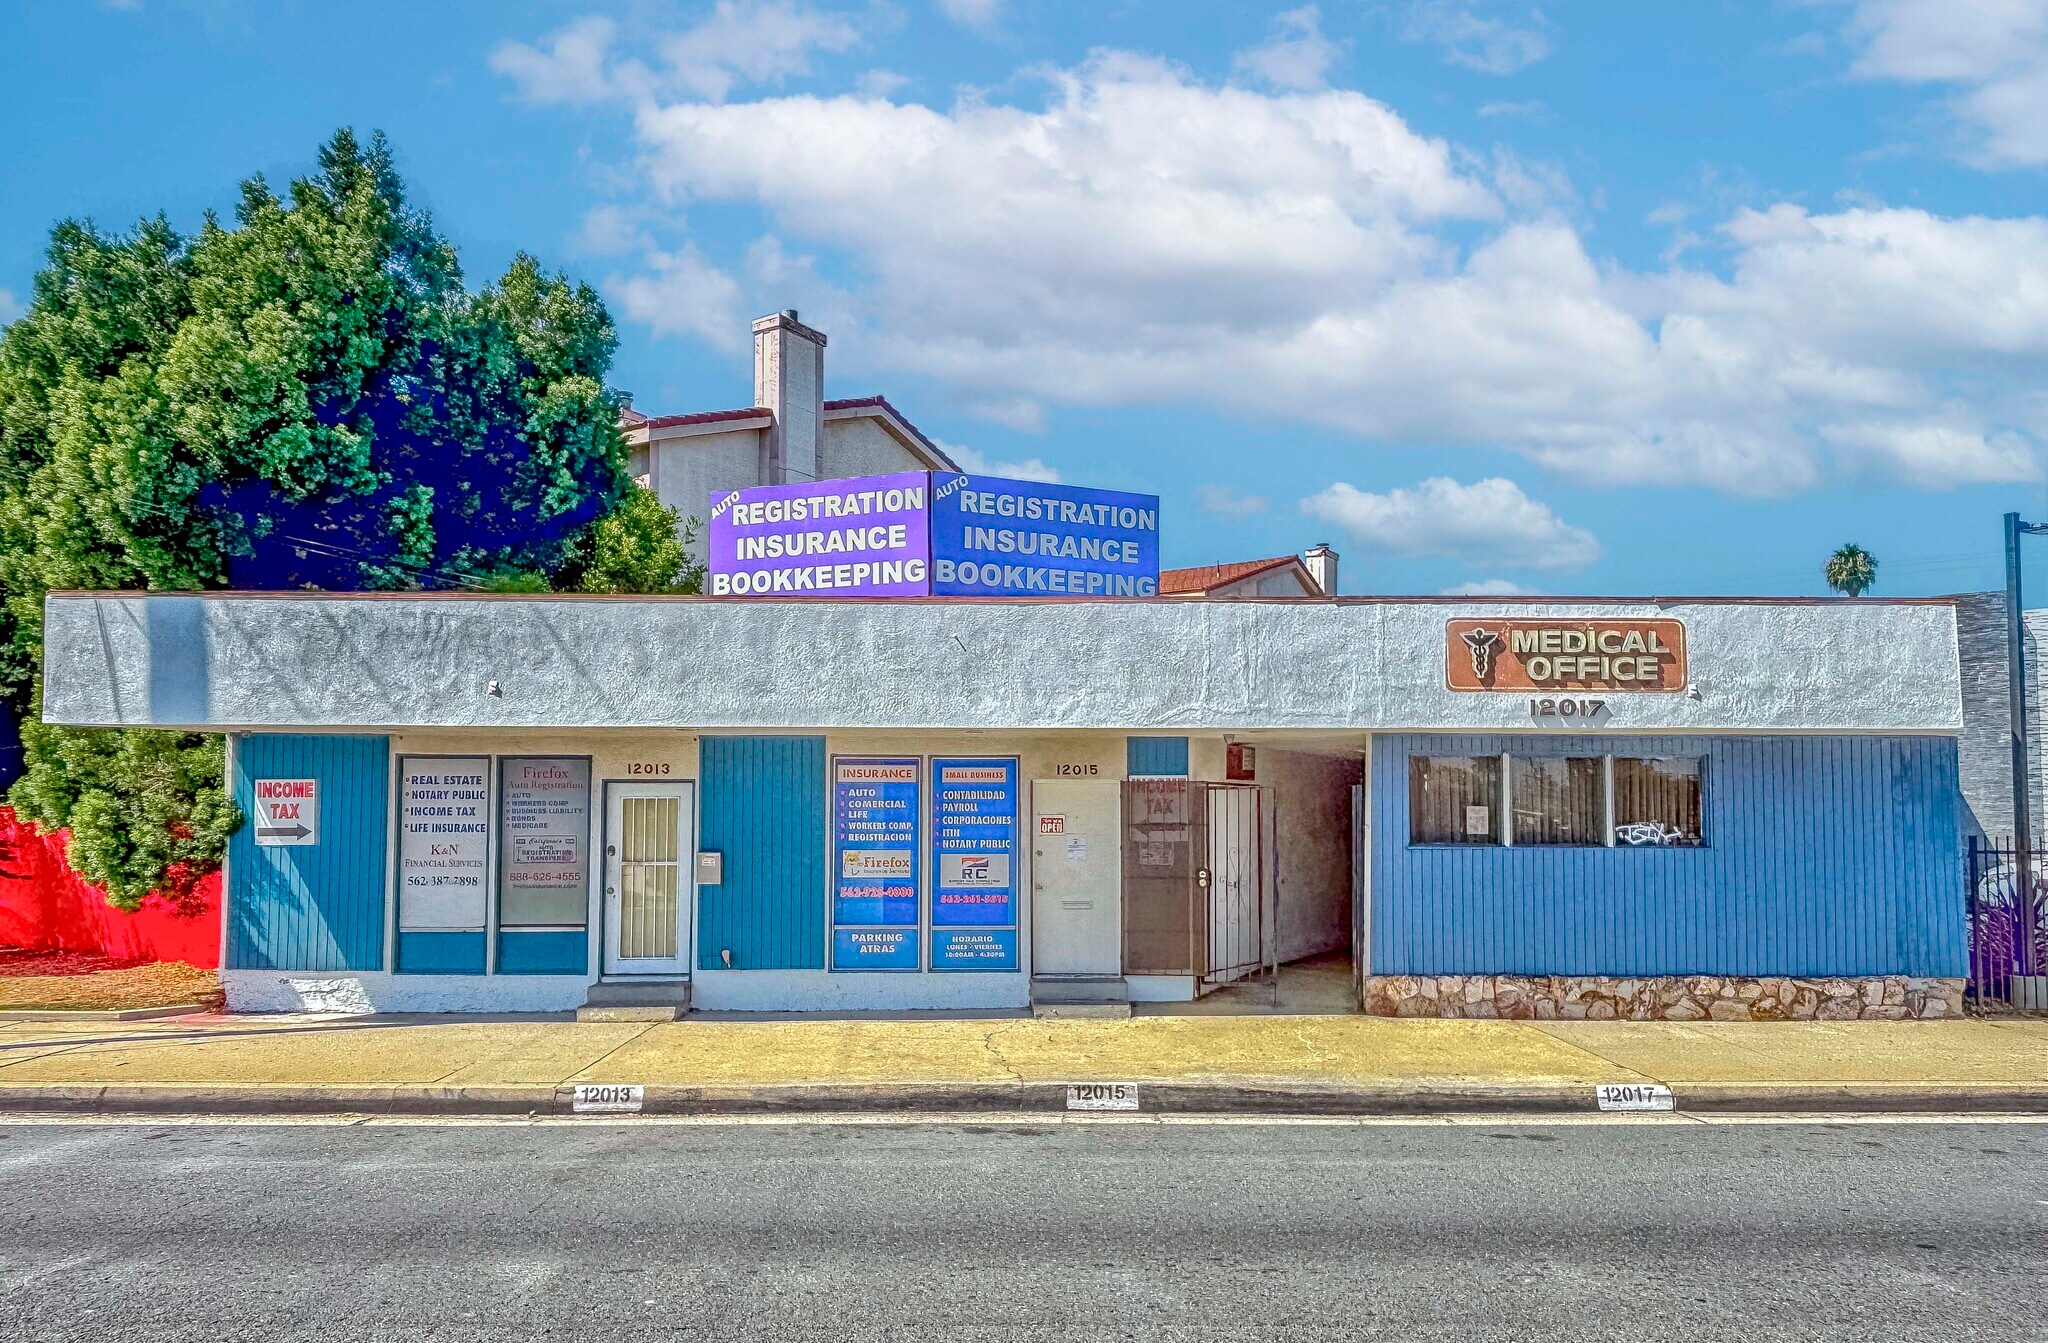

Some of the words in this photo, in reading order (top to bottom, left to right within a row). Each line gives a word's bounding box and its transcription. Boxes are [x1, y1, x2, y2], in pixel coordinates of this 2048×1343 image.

[935, 475, 969, 500] AUTO
[711, 490, 740, 520] AUTO
[732, 487, 923, 527] REGISTRATION
[960, 490, 1156, 531] REGISTRATION
[736, 524, 907, 560] INSURANCE
[964, 526, 1139, 564] INSURANCE
[713, 559, 925, 596] BOOKKEEPING
[936, 559, 1156, 597] BOOKKEEPING
[1511, 629, 1670, 653] MEDICAL
[1526, 656, 1659, 681] OFFICE
[1530, 699, 1606, 717] 12017
[523, 766, 569, 779] Firefox
[627, 763, 671, 775] 12013
[843, 769, 912, 778] INSURANCE
[1057, 764, 1098, 775] 12015
[411, 775, 440, 785] REAL
[443, 775, 482, 785] ESTATE
[257, 782, 314, 799] INCOME
[508, 781, 529, 789] Auto
[531, 781, 584, 791] Registration
[411, 790, 449, 800] NOTARY
[452, 790, 486, 800] PUBLIC
[848, 788, 876, 797] AUTO
[943, 790, 1006, 800] CONTABILIDAD
[848, 800, 907, 808] COMERCIAL
[942, 803, 979, 812] PAYROLL
[270, 803, 300, 819] TAX
[410, 806, 453, 816] INCOME
[456, 806, 476, 816] TAX
[848, 810, 868, 819] LIFE
[848, 822, 886, 830] WORKERS
[888, 822, 914, 830] COMP.
[942, 816, 1012, 825] CORPORACIONES
[410, 823, 429, 833] LIFE
[431, 823, 486, 833] INSURANCE
[1041, 823, 1063, 833] OPEN
[848, 833, 912, 841] REGISTRACION
[942, 839, 978, 849] NOTARY
[980, 839, 1011, 849] PUBLIC
[864, 856, 910, 868] Firefox
[852, 933, 903, 942] PARKING
[952, 935, 993, 943] HORARIO
[860, 945, 896, 953] ATRAS
[582, 1086, 631, 1103] 12013
[1074, 1084, 1126, 1101] 12015
[1603, 1086, 1655, 1103] 12017
